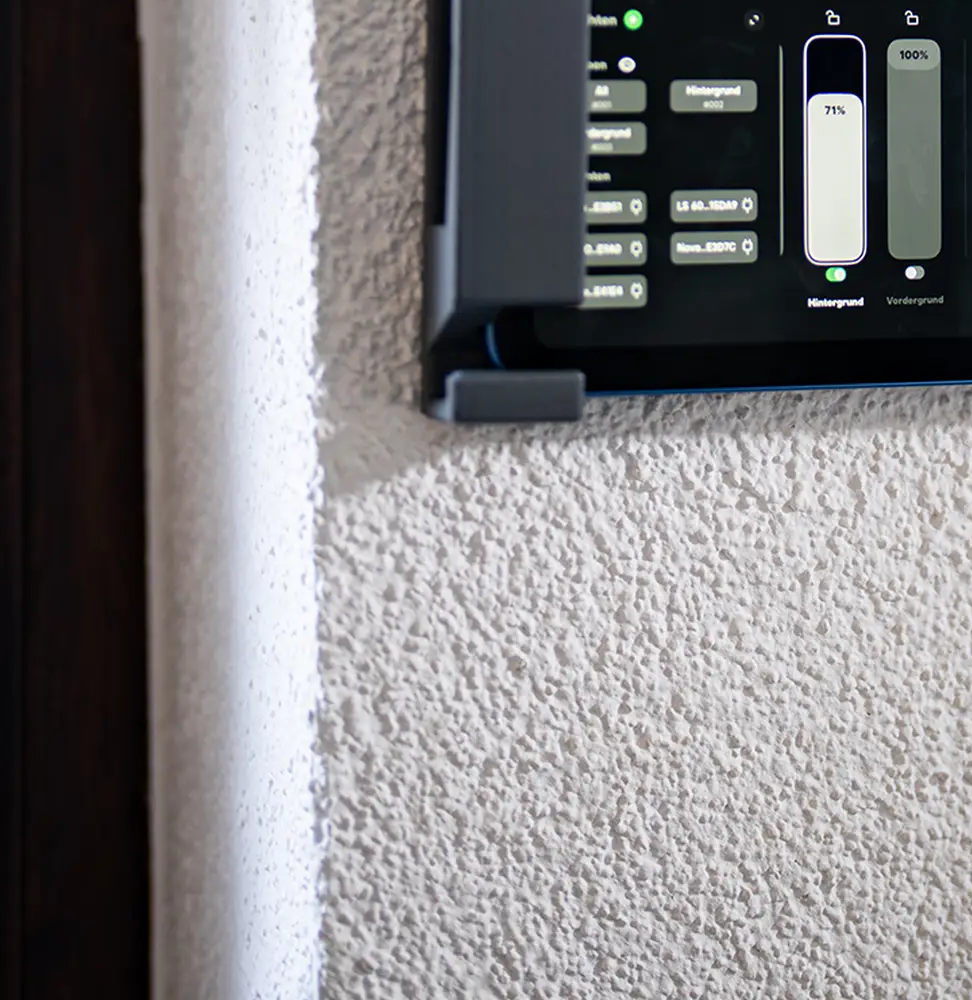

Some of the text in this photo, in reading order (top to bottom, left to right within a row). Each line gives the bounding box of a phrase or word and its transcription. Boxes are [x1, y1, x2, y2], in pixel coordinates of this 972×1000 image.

[899, 50, 929, 60] 100%
[685, 84, 742, 98] Hintergrund
[824, 105, 846, 115] 71%
[676, 200, 690, 213] LS
[807, 296, 865, 309] Hintergrund
[886, 295, 944, 307] Vordergrund
